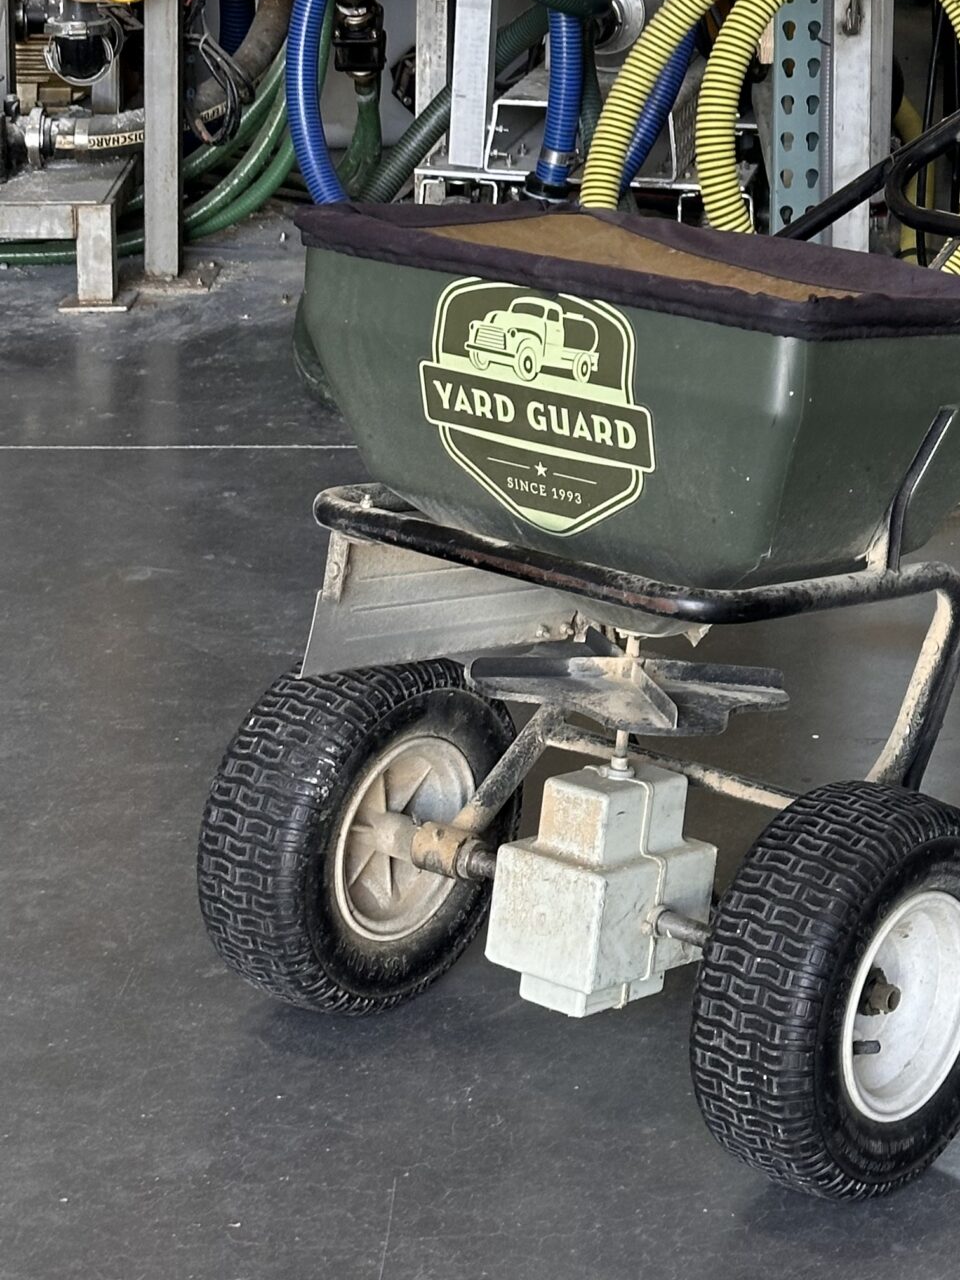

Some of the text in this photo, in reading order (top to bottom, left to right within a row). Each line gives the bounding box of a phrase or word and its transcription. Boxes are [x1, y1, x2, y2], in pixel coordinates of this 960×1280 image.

[432, 379, 637, 451] YARD GUARD
[506, 476, 583, 505] SINCE 1993
